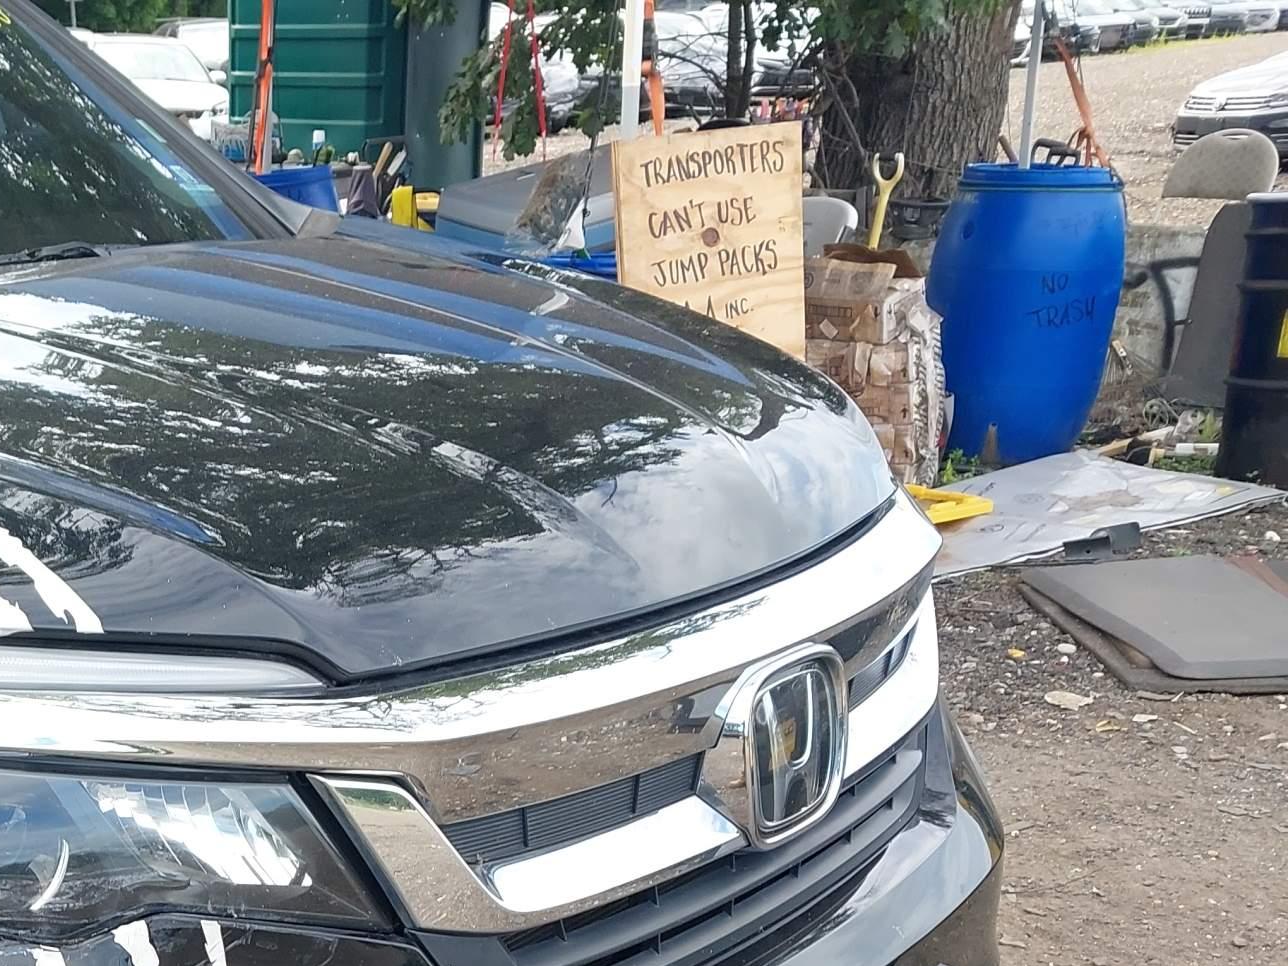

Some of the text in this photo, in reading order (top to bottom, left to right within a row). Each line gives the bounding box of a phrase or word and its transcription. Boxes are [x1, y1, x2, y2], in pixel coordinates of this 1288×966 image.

[640, 140, 784, 187] TRANSPORTERS
[648, 196, 757, 239] CAN'T USE
[652, 239, 778, 287] JUMP PACKS
[1041, 273, 1069, 295] NO
[1027, 296, 1096, 328] TRASH
